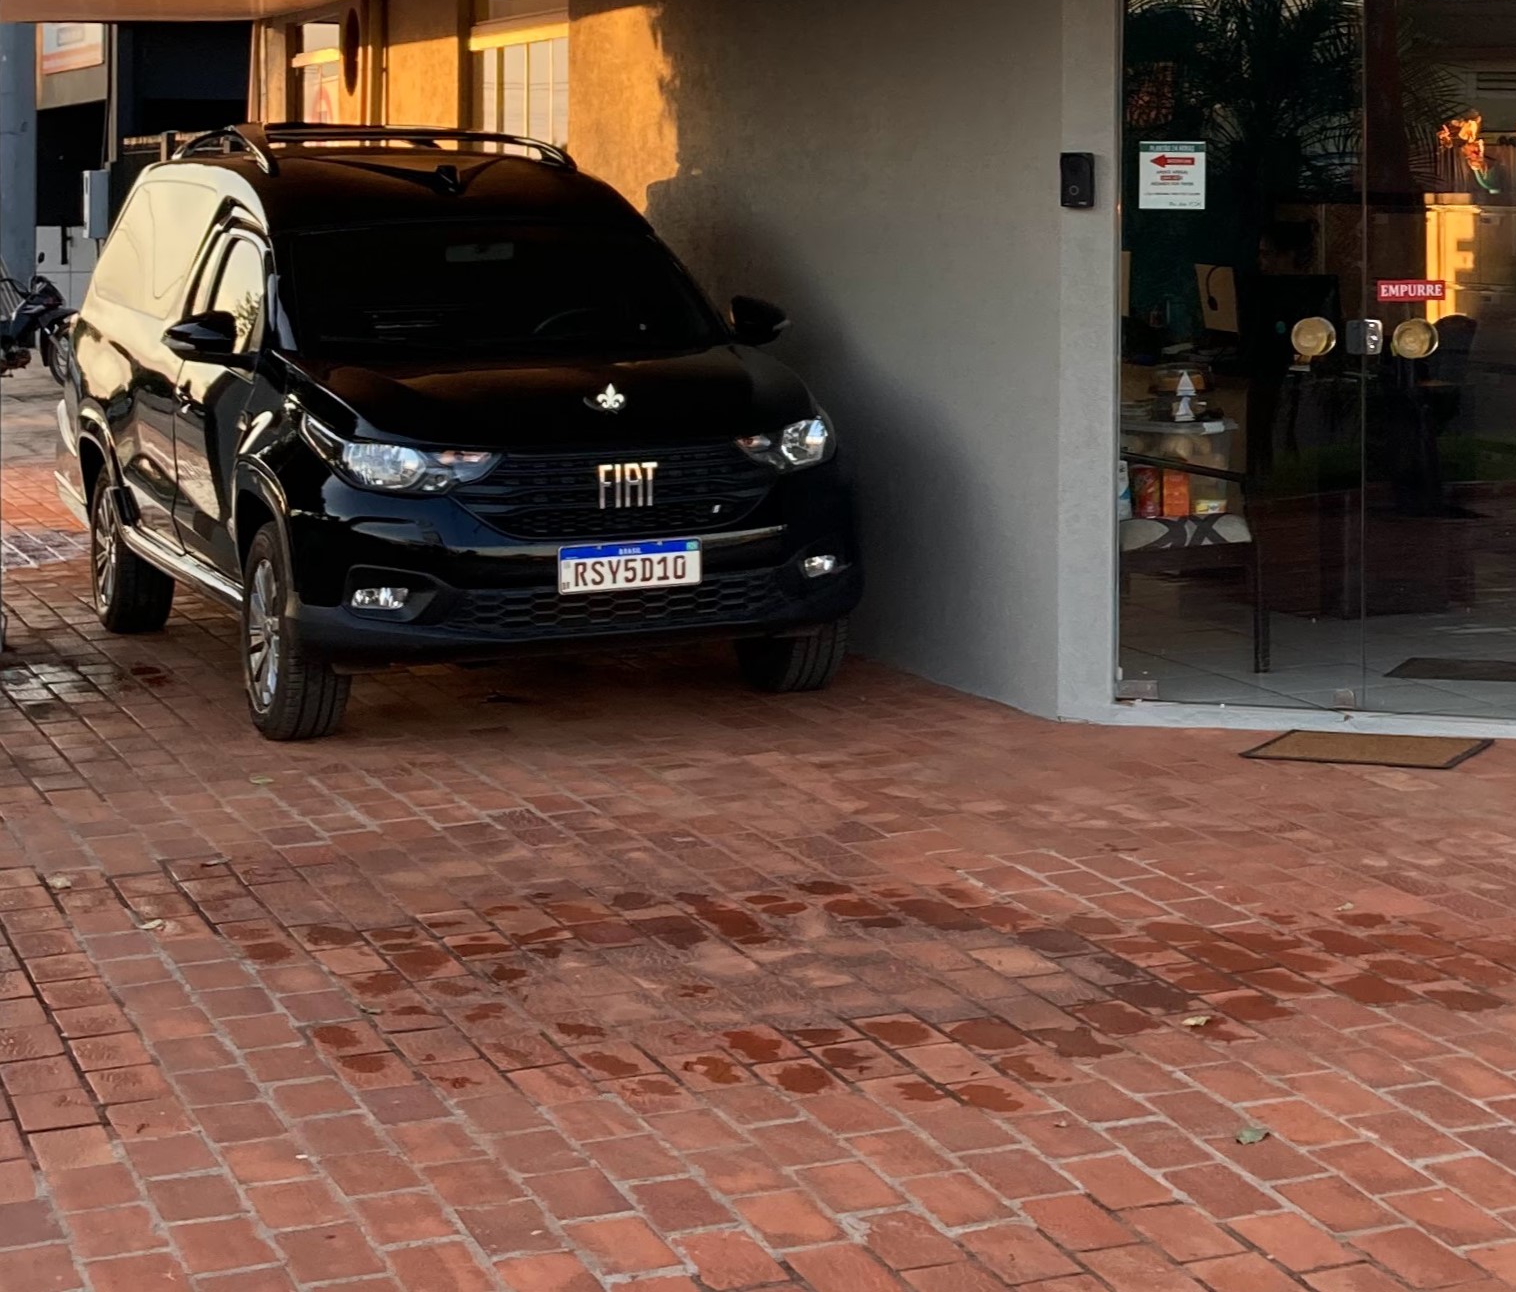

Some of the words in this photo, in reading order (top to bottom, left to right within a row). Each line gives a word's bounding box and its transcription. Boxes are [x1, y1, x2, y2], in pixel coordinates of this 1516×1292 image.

[1380, 284, 1443, 297] EMPURRE
[598, 461, 658, 509] FIAT
[618, 547, 642, 555] BRASIL
[574, 555, 687, 587] RSY5D10
